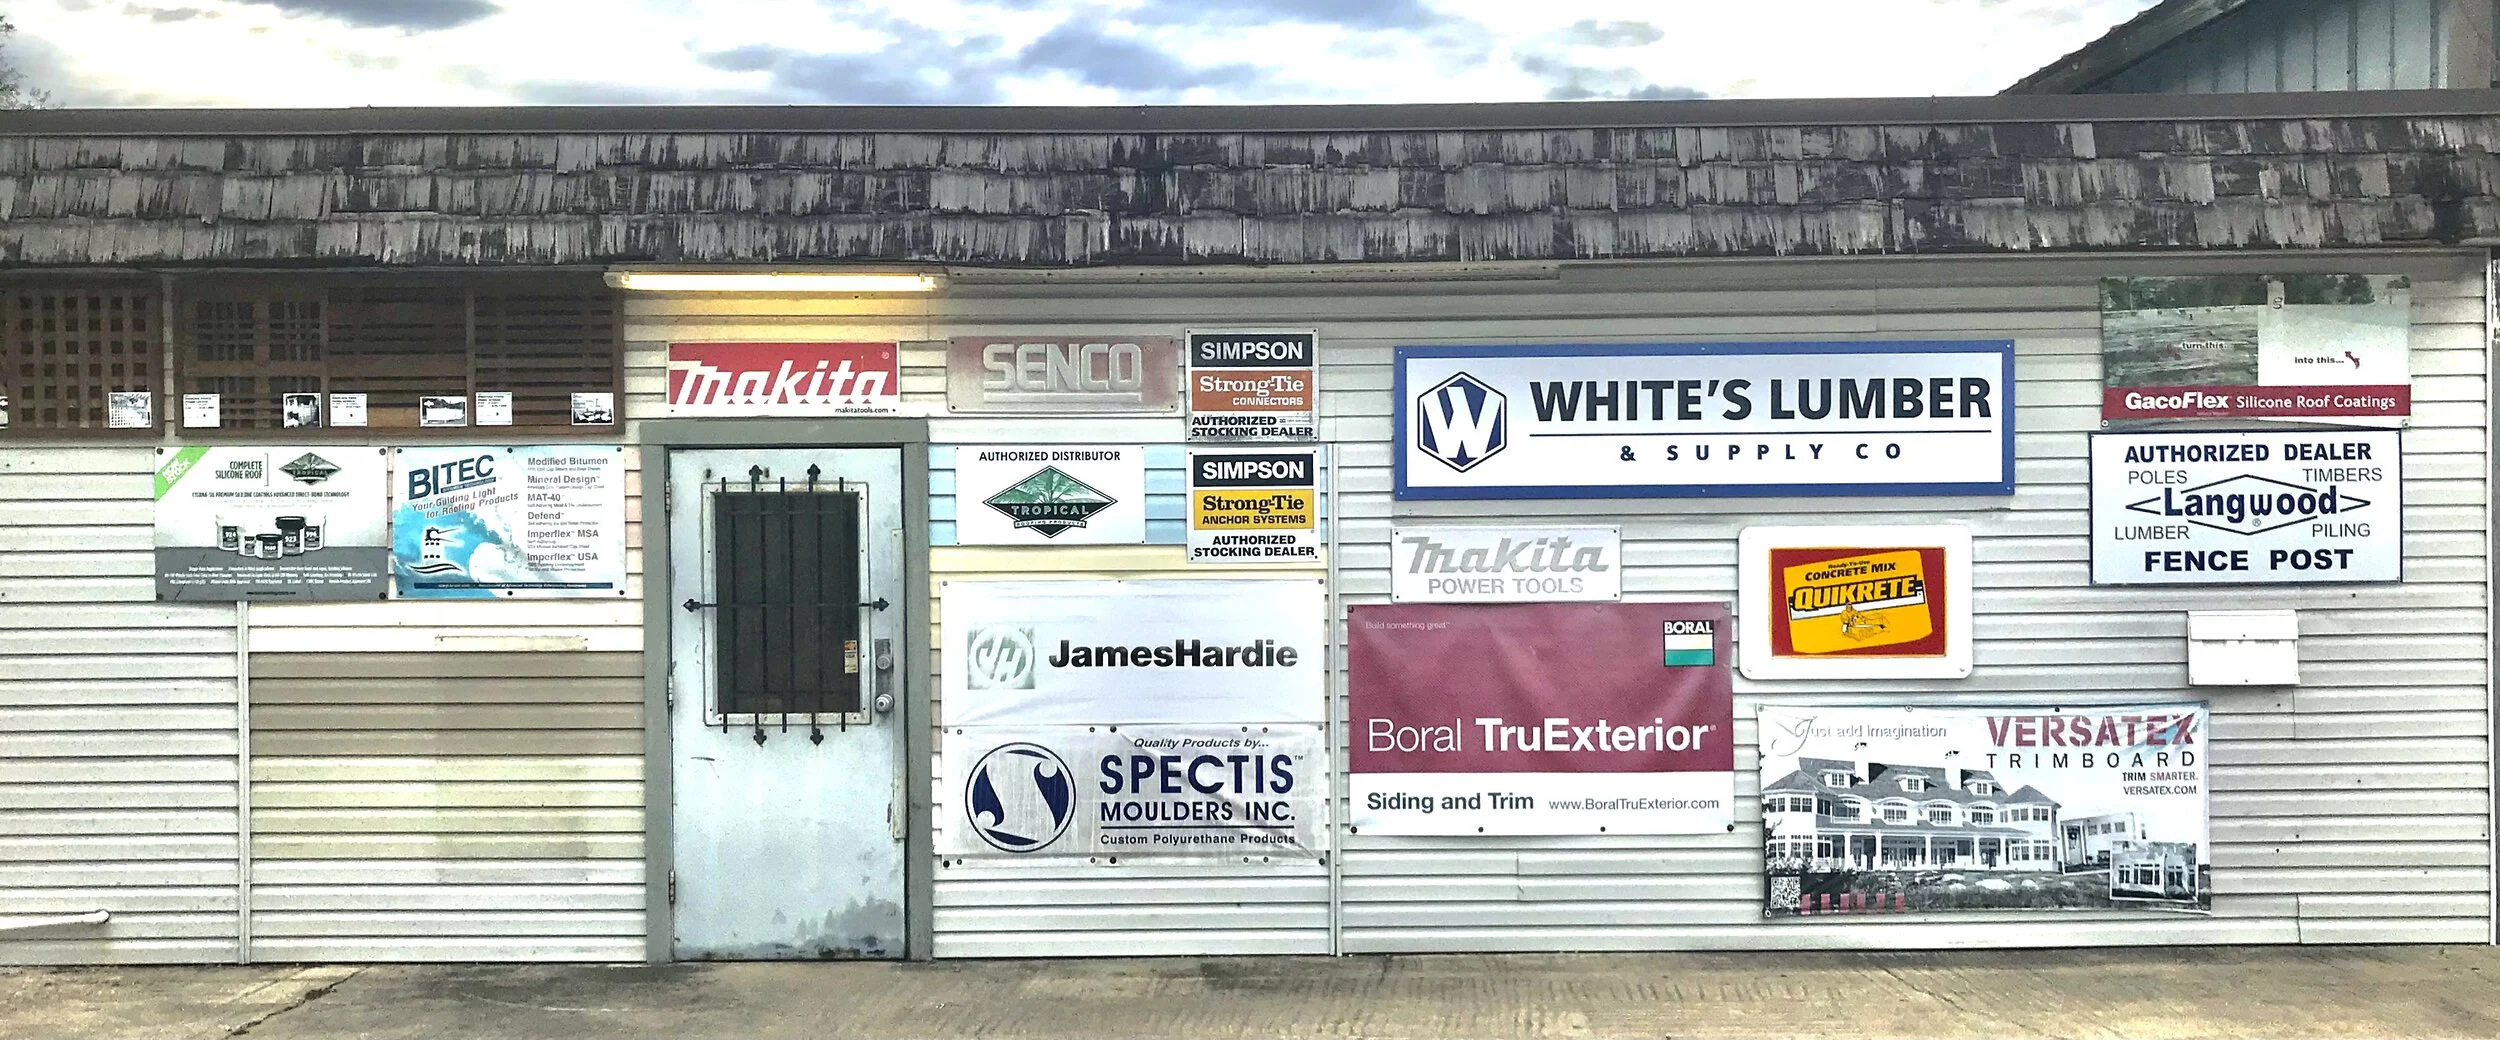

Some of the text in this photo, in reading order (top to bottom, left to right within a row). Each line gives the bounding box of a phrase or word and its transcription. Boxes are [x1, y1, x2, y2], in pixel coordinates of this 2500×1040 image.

[1200, 342, 1303, 360] SIMPSON
[983, 344, 1142, 390] SENCO
[2294, 356, 2313, 364] into
[669, 360, 897, 404] makita
[1200, 375, 1304, 396] Strong-Tie
[1232, 397, 1304, 406] CONNECTORS
[1530, 376, 1992, 422] WHITE'S LUMBER
[2125, 392, 2396, 411] GacoFlex Silicone Roof Coatings
[835, 406, 888, 414] makitatools.com
[1192, 416, 1276, 426] AUTHORIZED
[1192, 427, 1313, 436] STOCKING DEALER
[979, 451, 1121, 461] AUTHORIZED DISTRIBUTOR
[1620, 442, 1902, 461] & SUPPLY CO
[2124, 442, 2372, 463] AUTHORIZED DEALER
[230, 461, 262, 470] COMPLETE
[528, 457, 608, 465] Modified Bitumen
[215, 470, 262, 479] SILICONE ROOF
[409, 454, 494, 500] BITEC
[1202, 461, 1304, 480] SIMPSON
[2128, 468, 2382, 484] POLES TIMBERS
[528, 475, 596, 485] Mineral Design
[412, 486, 496, 512] Your Guiding Light
[442, 502, 476, 516] Roofing
[479, 492, 518, 507] Products
[528, 493, 561, 501] MAT-40
[1203, 495, 1304, 514] Strong-Tie
[2164, 486, 2336, 523] Langwood
[528, 512, 561, 520] Defend
[1011, 505, 1089, 515] TROPICAL
[1202, 515, 1306, 524] ANCHOR SYSTEMS
[528, 530, 571, 539] Imperflex
[2114, 523, 2370, 540] LUMBER PILING
[1212, 535, 1296, 545] AUTHORIZED
[527, 553, 571, 562] Imperflex
[1194, 547, 1315, 557] STOCKING DEALER
[1402, 536, 1609, 574] makita
[2145, 549, 2354, 571] FENCE POST
[1805, 563, 1896, 581] CONCRETE MIX
[1429, 577, 1584, 594] POWER TOOLS
[1794, 576, 1915, 610] QUIKRETE
[1386, 622, 1425, 630] something
[1665, 621, 1713, 634] BORAL
[1048, 639, 1298, 667] JamesHardie
[1368, 718, 1709, 752] Boral TruExterior
[1837, 725, 1863, 737] add
[1987, 713, 2194, 747] VERSATEX
[1134, 738, 1269, 749] Quality Products by...
[1986, 752, 2194, 768] TRIMBOARD
[1100, 754, 1294, 794] SPECTIS
[2122, 772, 2198, 781] TRIM SMARTER.
[2123, 786, 2197, 795] VERSATEX.COM
[1101, 801, 1295, 821] MOULDERS INC.
[1368, 792, 1719, 814] Siding and Trim www.BoralTruExterior.com
[1101, 834, 1295, 846] Custom Polyurethane Products
